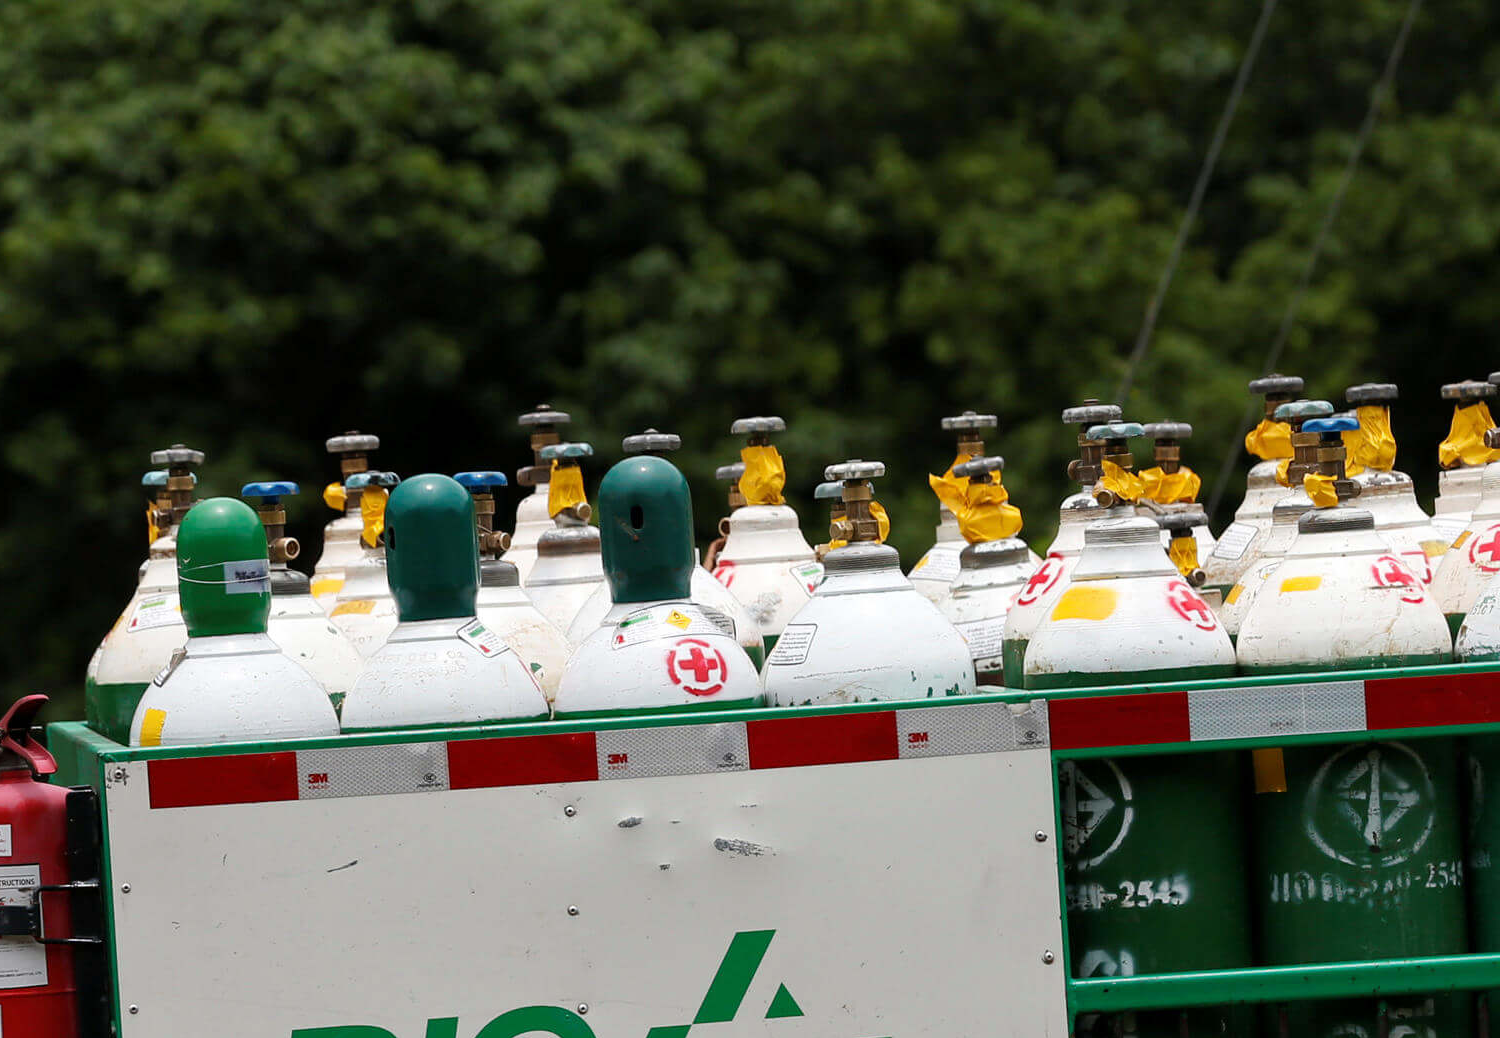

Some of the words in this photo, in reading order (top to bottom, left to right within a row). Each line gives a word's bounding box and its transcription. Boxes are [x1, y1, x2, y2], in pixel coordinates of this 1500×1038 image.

[908, 732, 928, 742] 3M
[608, 754, 627, 764] 3M
[308, 774, 328, 784] 3M
